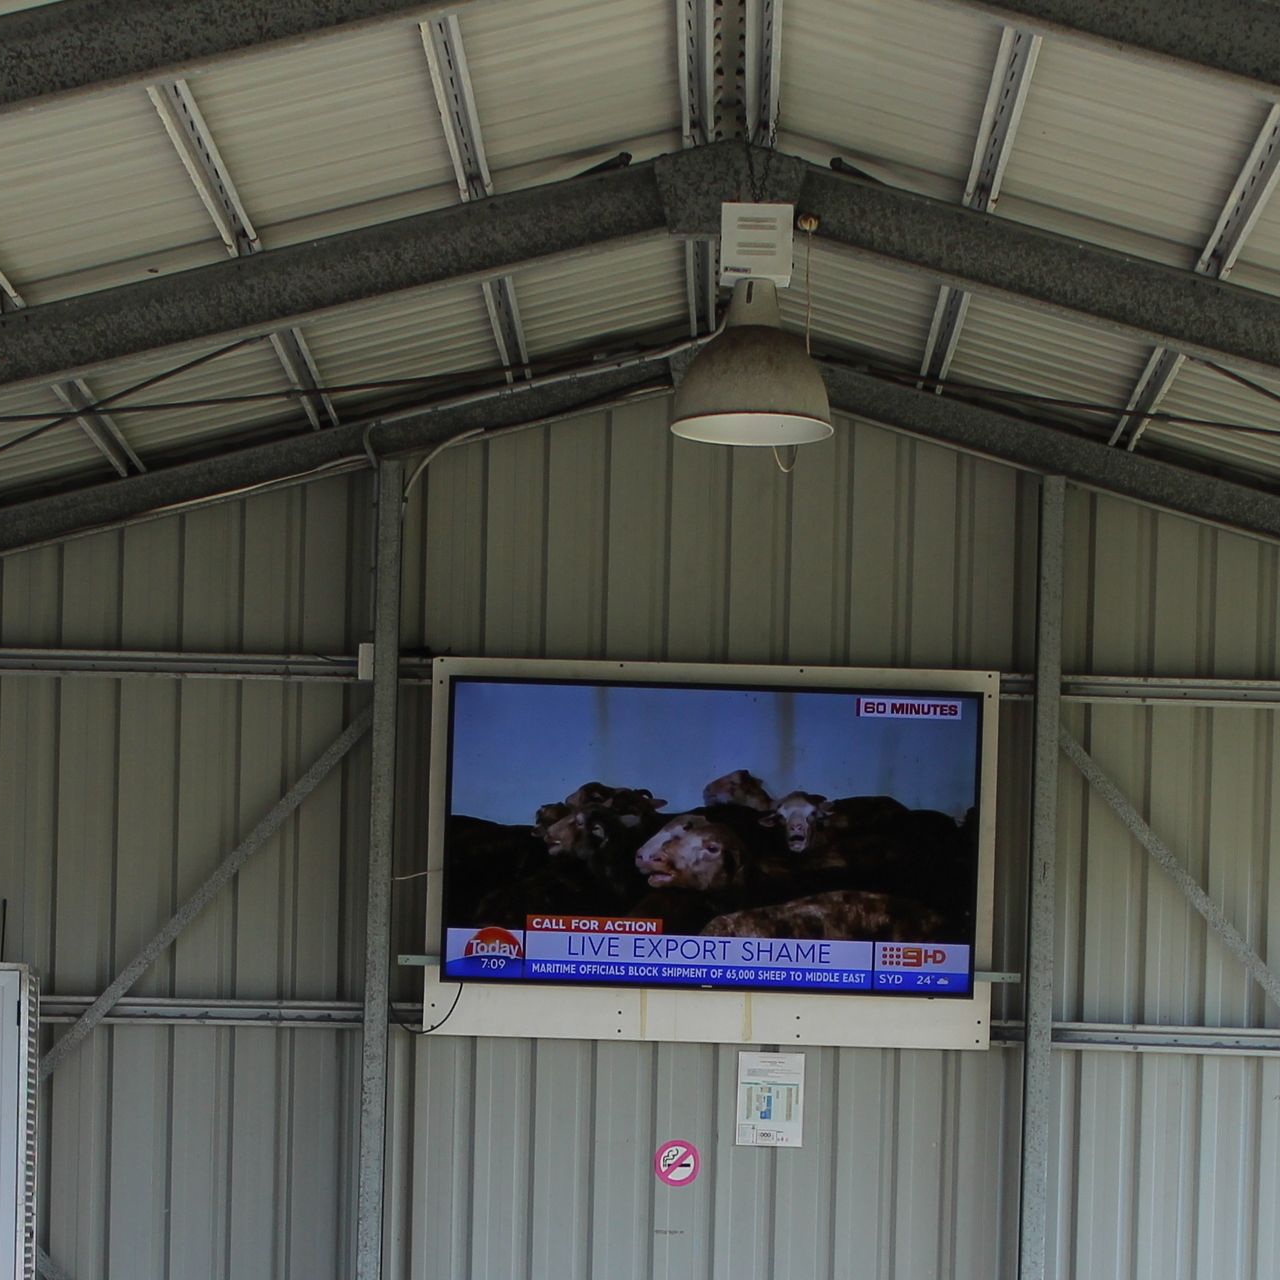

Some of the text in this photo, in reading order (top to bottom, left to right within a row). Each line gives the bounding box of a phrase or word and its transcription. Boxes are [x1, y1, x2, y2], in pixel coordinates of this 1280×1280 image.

[864, 702, 958, 716] 60 MINUTES
[532, 918, 657, 932] CALL FOR ACTION
[470, 939, 519, 959] Today
[568, 936, 831, 964] LIVE EXPORT SHAME
[481, 958, 506, 969] 7:09
[532, 963, 866, 984] MARITIME OFFICIALS BLOCK SHIPMENT OF 65,000 SHEEP TO MIDDLE EAST
[879, 974, 903, 985] SYD
